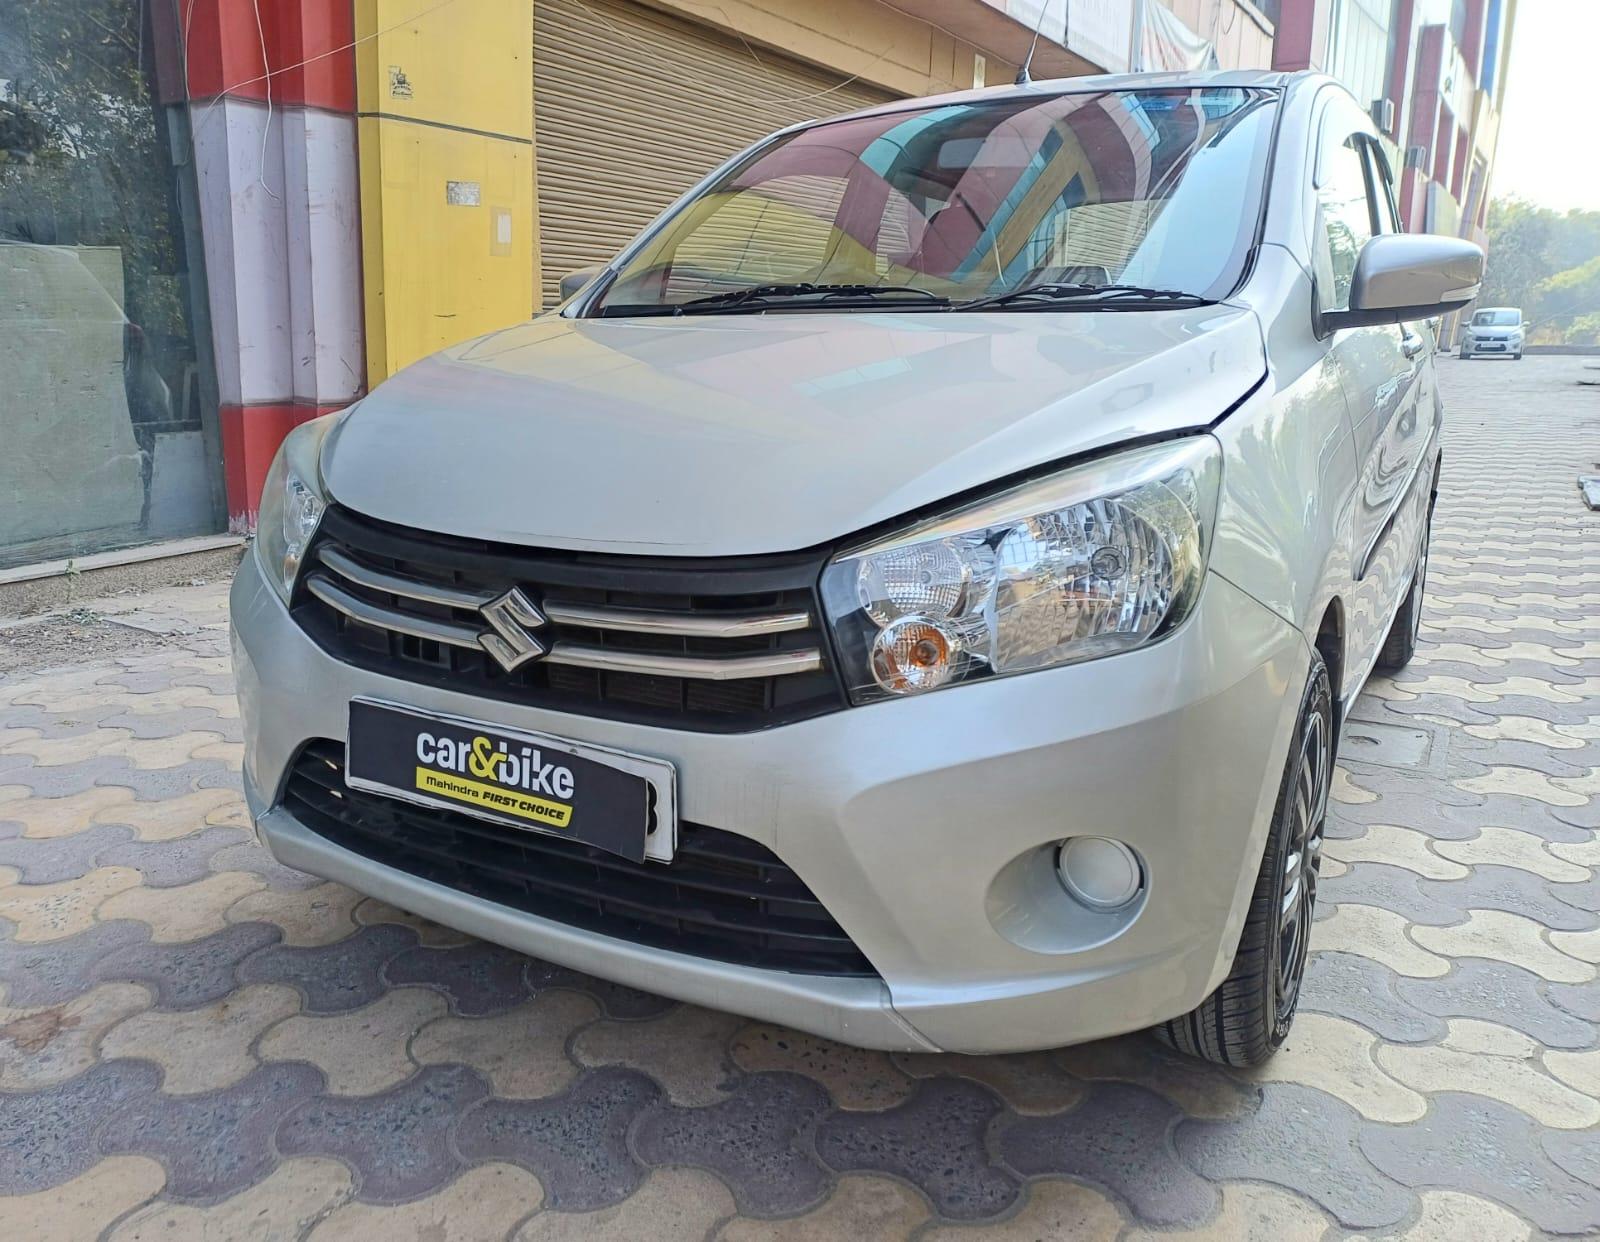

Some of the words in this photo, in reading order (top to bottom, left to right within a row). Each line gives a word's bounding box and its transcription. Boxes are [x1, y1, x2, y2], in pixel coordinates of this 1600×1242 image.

[416, 732, 575, 799] car&bike
[426, 775, 479, 798] Mahindra
[482, 791, 518, 808] FIRST
[519, 801, 565, 821] CHOICE
